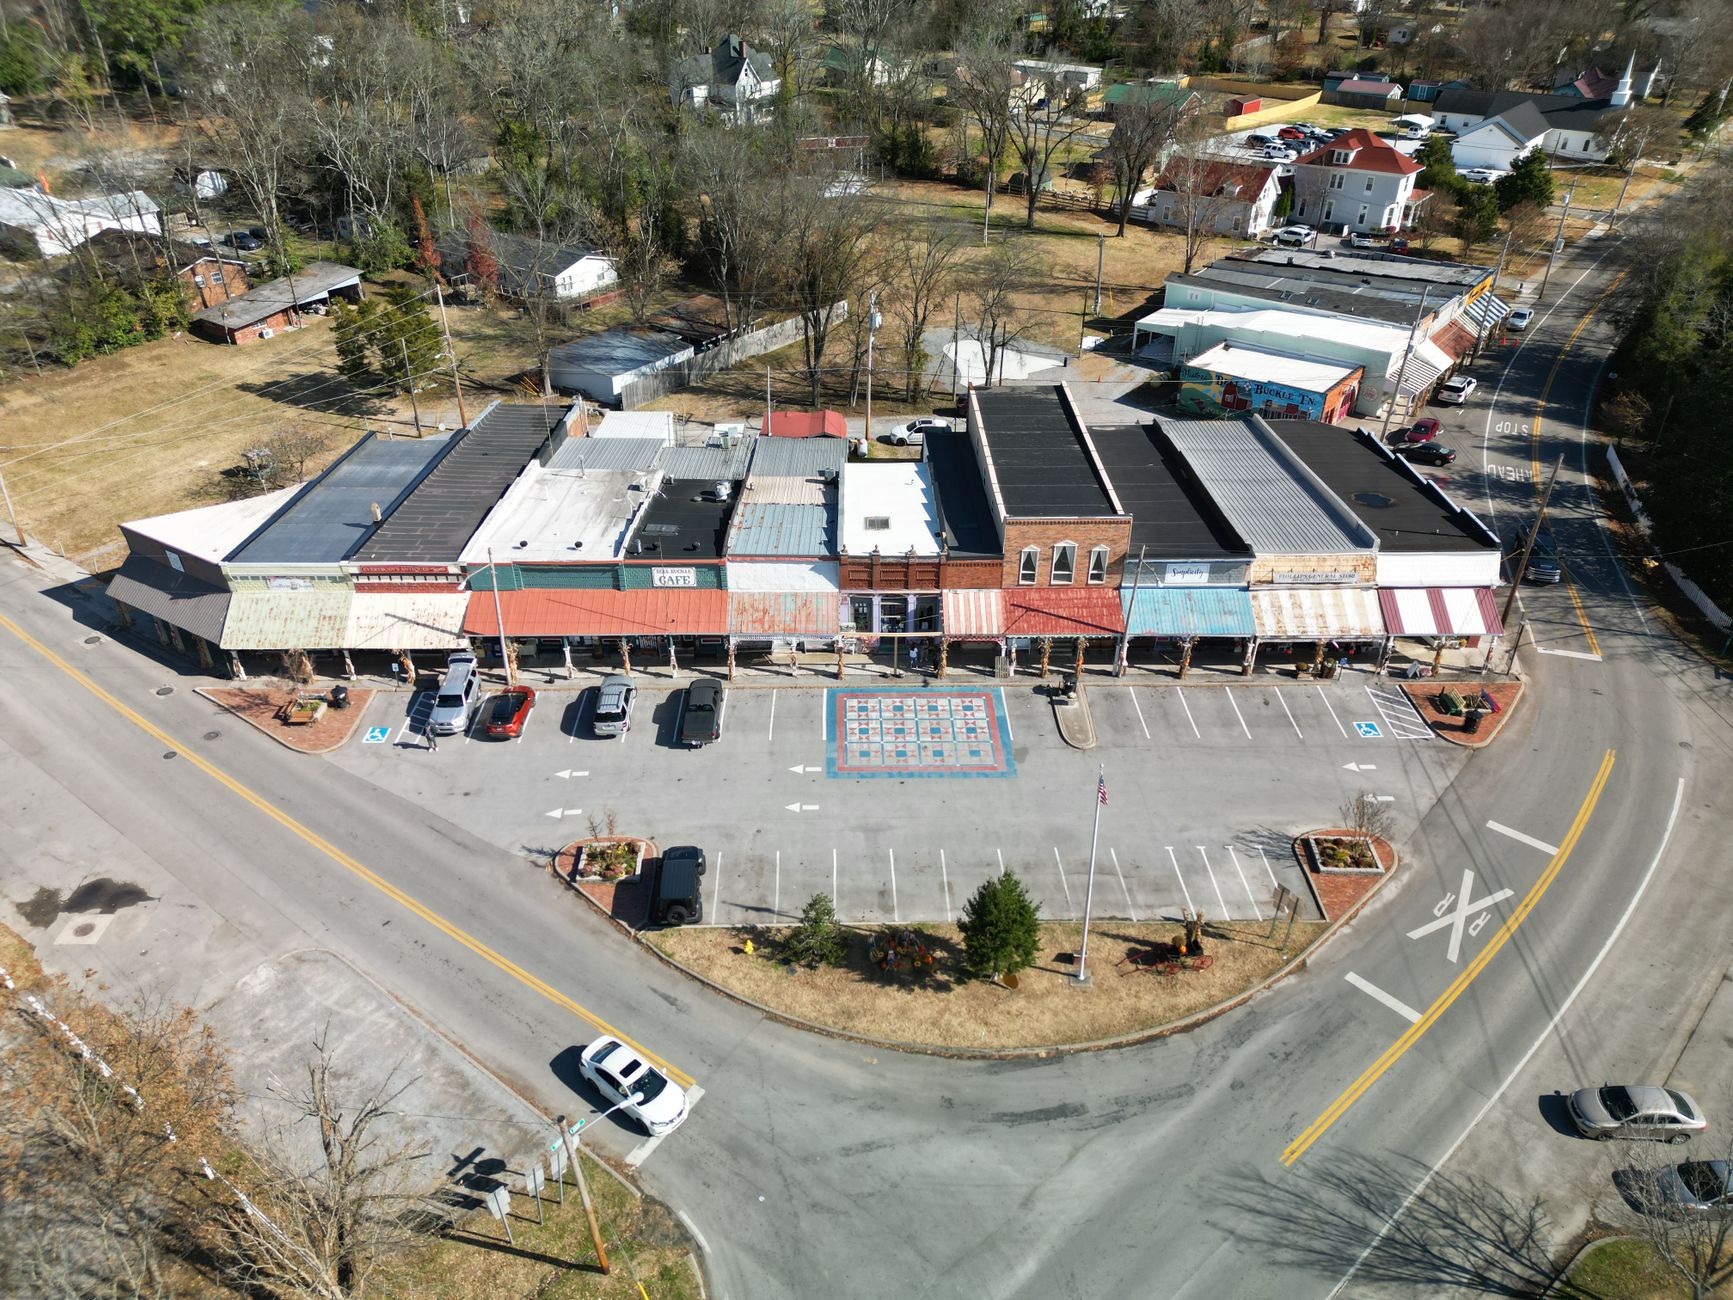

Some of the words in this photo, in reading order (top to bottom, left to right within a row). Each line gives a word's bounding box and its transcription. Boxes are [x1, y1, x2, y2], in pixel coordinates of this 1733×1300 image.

[1255, 383, 1295, 400] BUCKLE
[1495, 421, 1529, 436] STOP
[1487, 464, 1533, 482] AHEAD
[658, 575, 691, 585] CAFE
